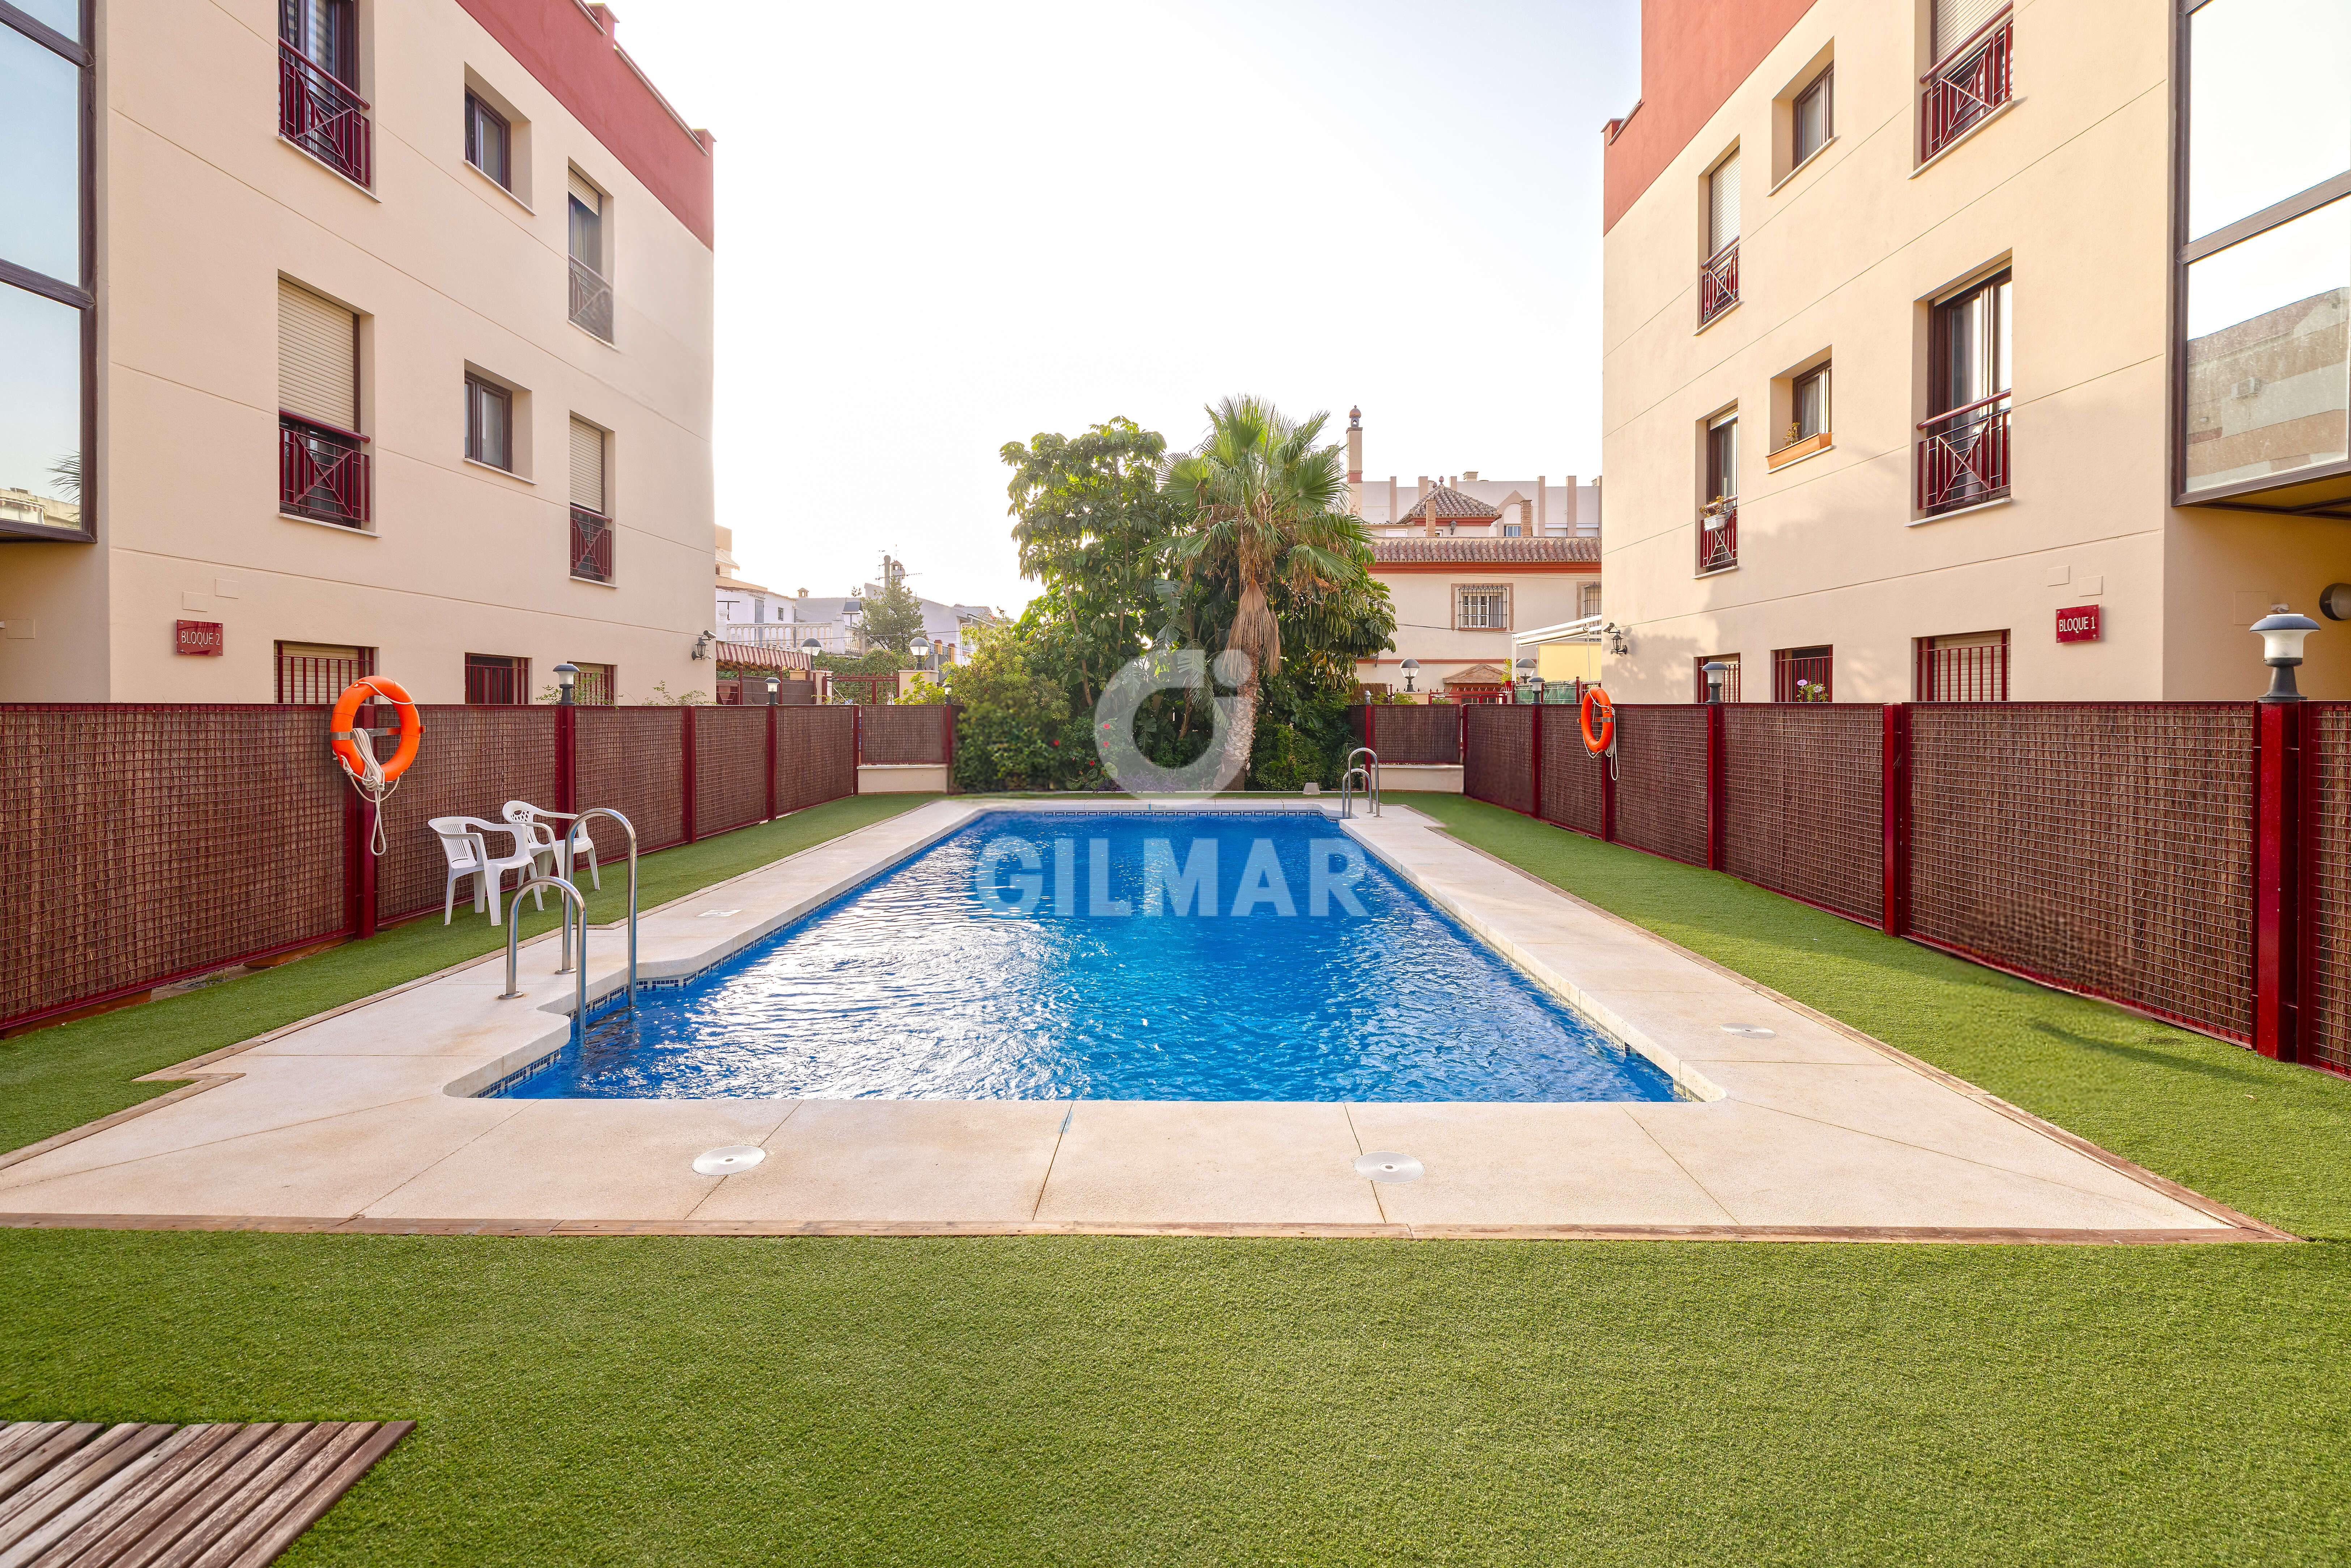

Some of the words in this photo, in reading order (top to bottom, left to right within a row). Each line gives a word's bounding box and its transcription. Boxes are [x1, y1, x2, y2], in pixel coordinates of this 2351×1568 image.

[2059, 617, 2089, 633] BLOQUE
[2091, 616, 2095, 629] 1
[182, 631, 213, 647] BLOQUE
[216, 633, 220, 645] 2
